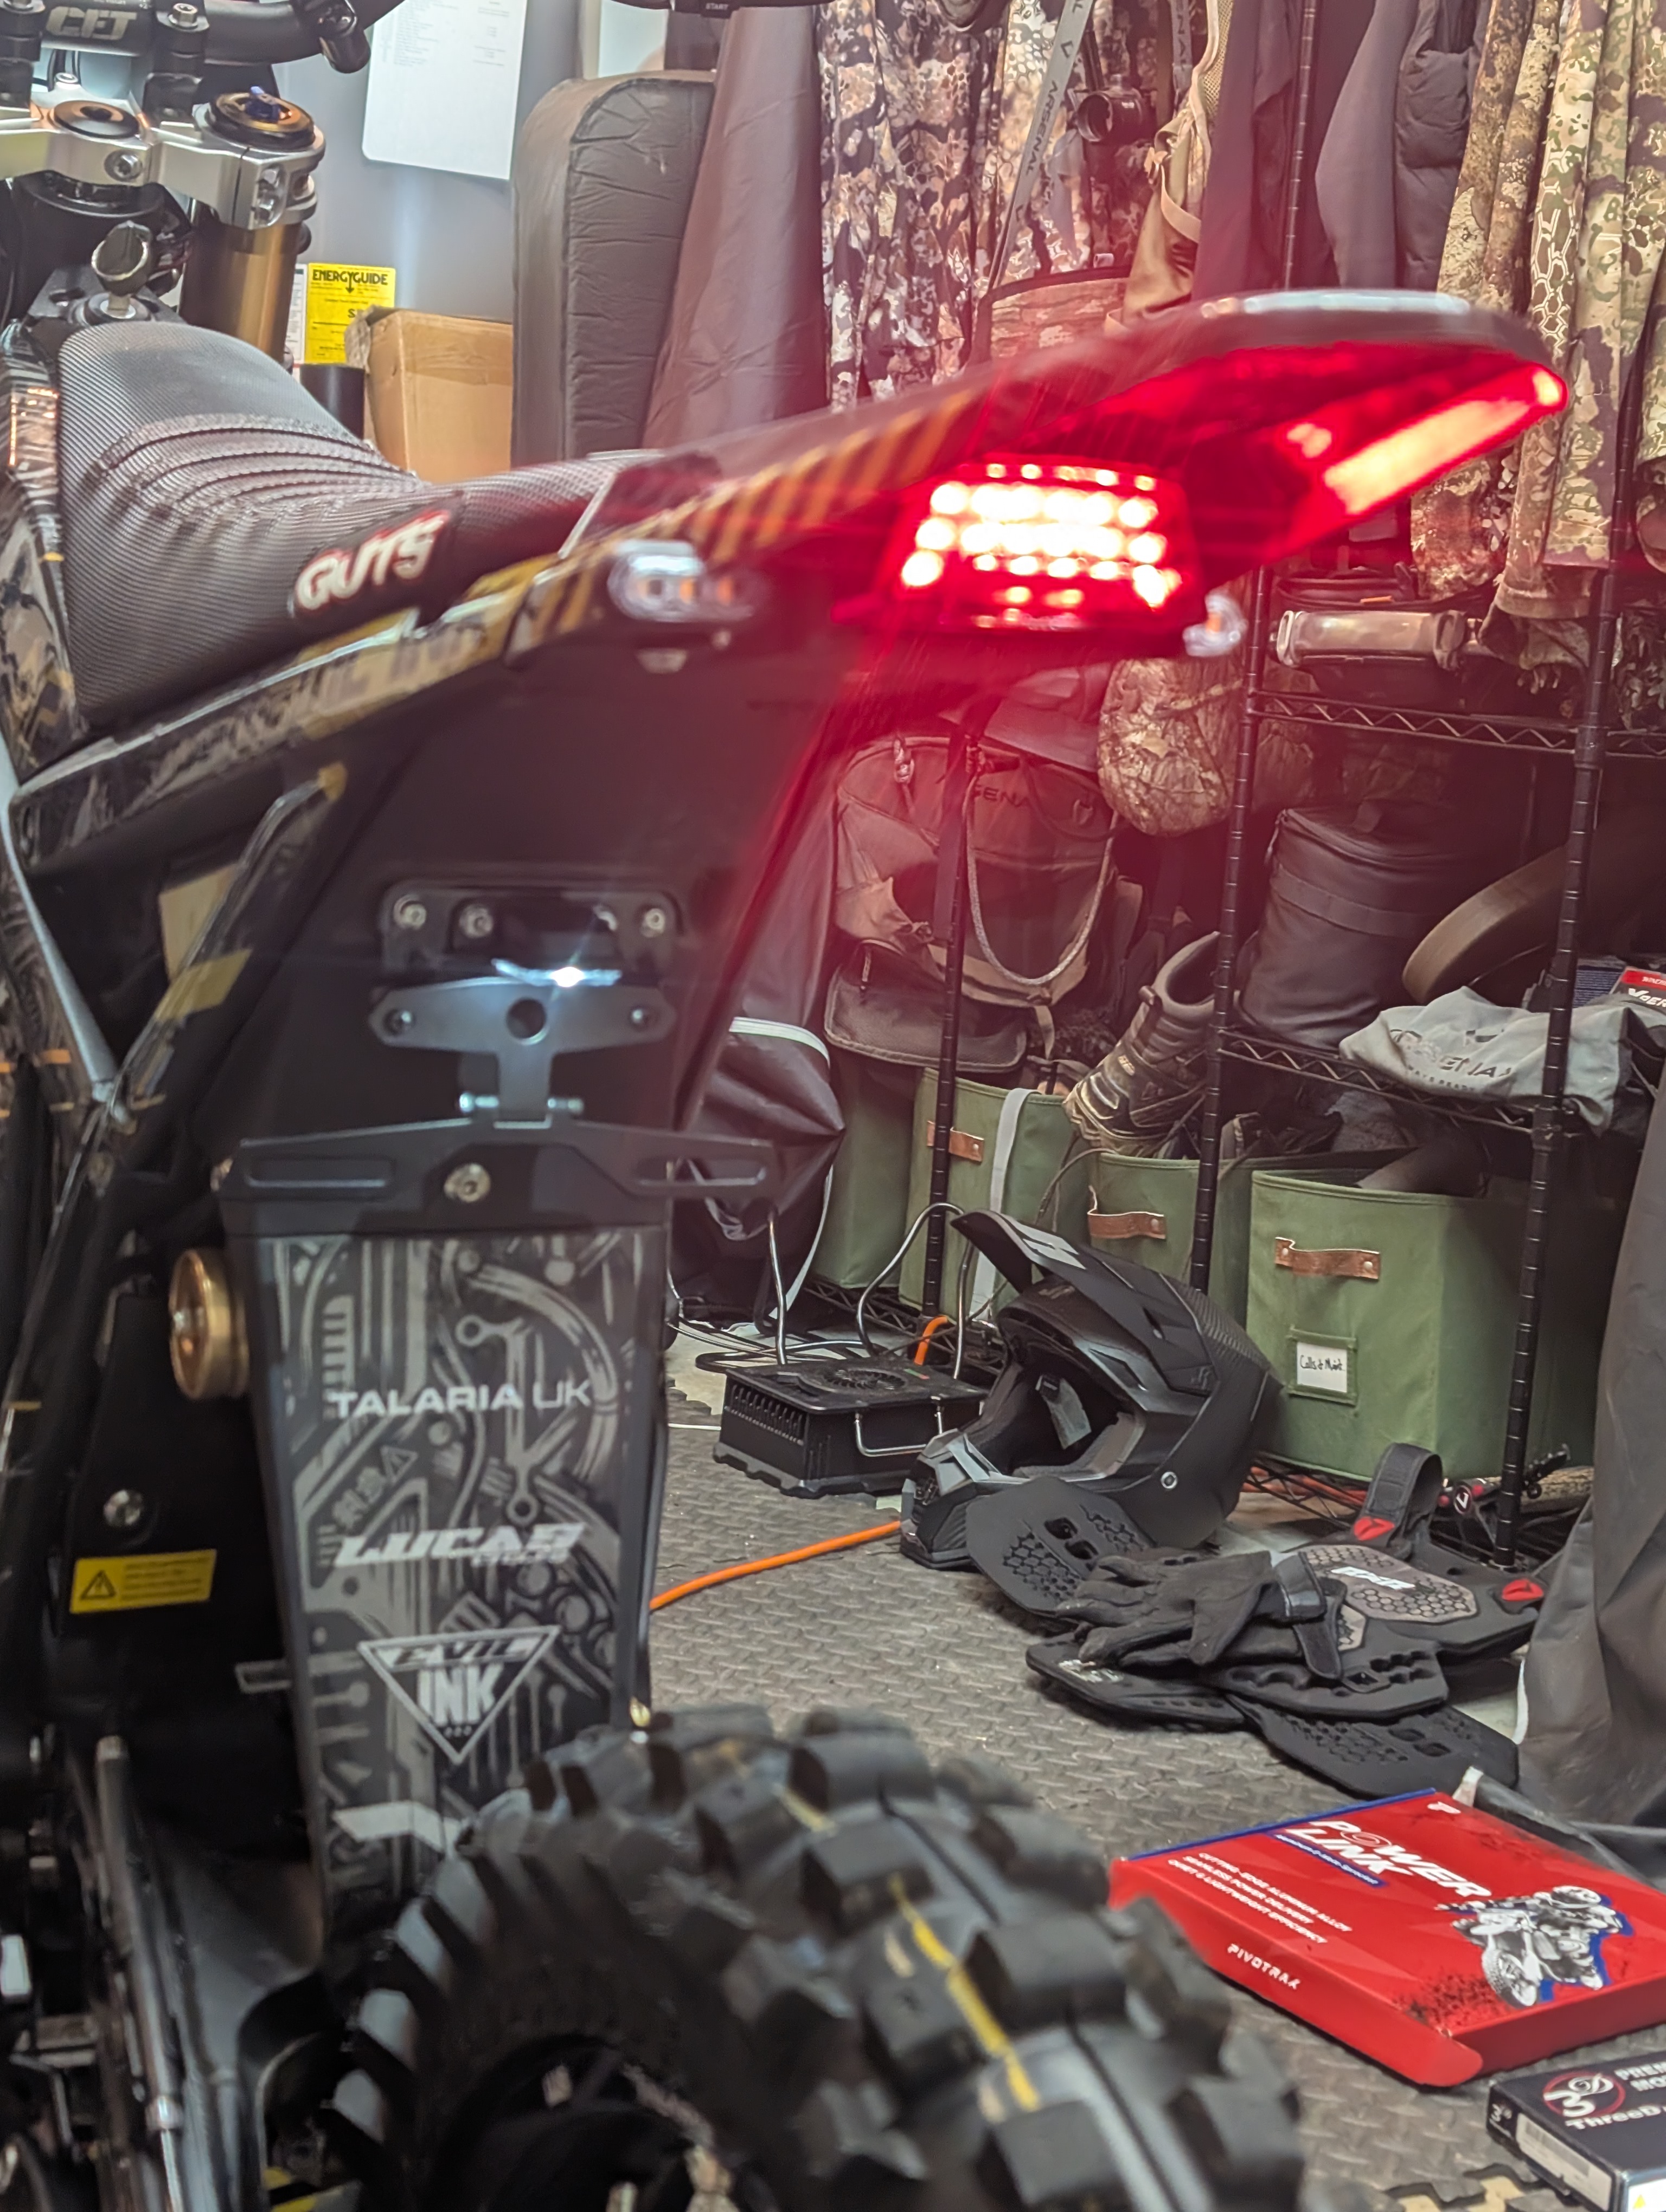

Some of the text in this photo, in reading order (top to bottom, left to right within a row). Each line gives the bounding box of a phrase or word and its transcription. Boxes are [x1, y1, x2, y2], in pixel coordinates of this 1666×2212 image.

[1027, 80, 1058, 176] ARSENAL
[297, 512, 446, 610] GUTS
[327, 1380, 591, 1418] TALARIA UK
[335, 1522, 585, 1566] LUCAS
[1284, 1828, 1414, 1875] LINK
[1309, 1820, 1492, 1898] POWER
[1316, 1913, 1353, 1932] ALLOY
[1565, 2105, 1662, 2130] ThreeD
